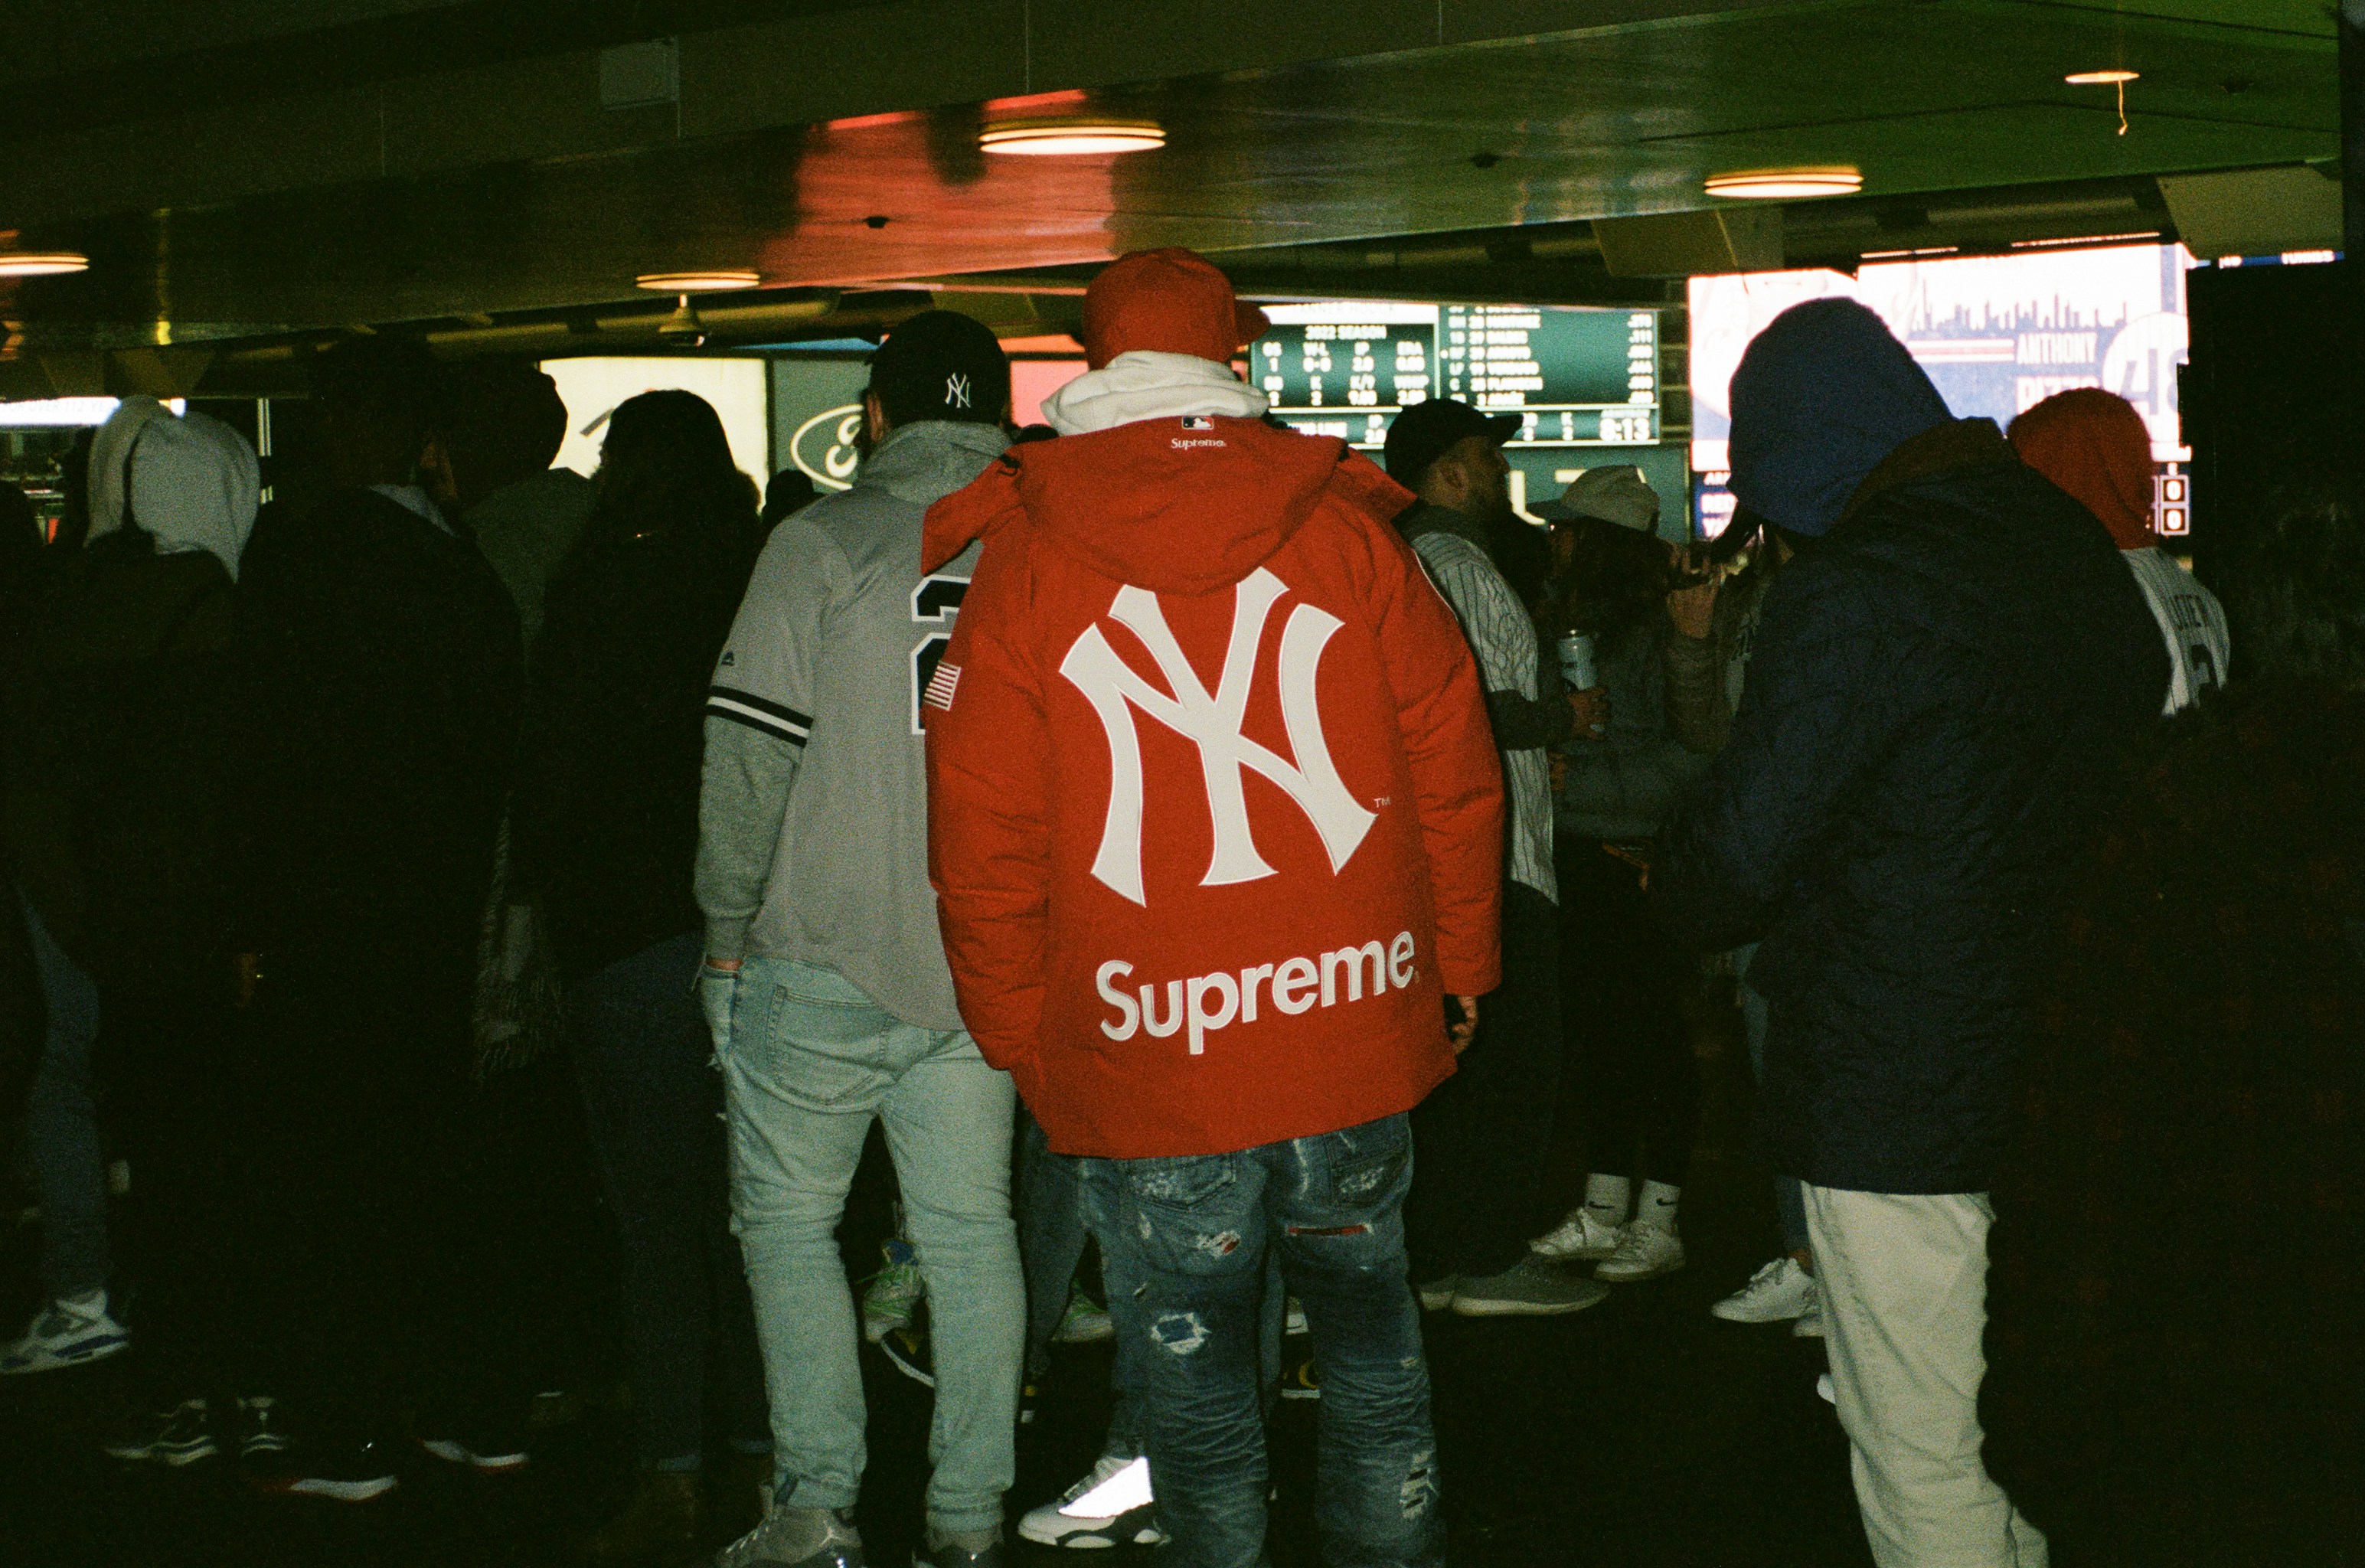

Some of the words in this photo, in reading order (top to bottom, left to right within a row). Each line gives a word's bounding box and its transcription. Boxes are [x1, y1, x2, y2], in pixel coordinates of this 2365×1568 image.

[1338, 325, 1387, 340] SEASON
[2017, 332, 2097, 364] ANTHONY
[945, 372, 972, 408] NY
[1171, 437, 1226, 451] Supreme
[2166, 479, 2182, 501] 0
[2166, 508, 2183, 531] 0
[1060, 567, 1378, 907] NY
[1096, 931, 1415, 1055] Supreme
